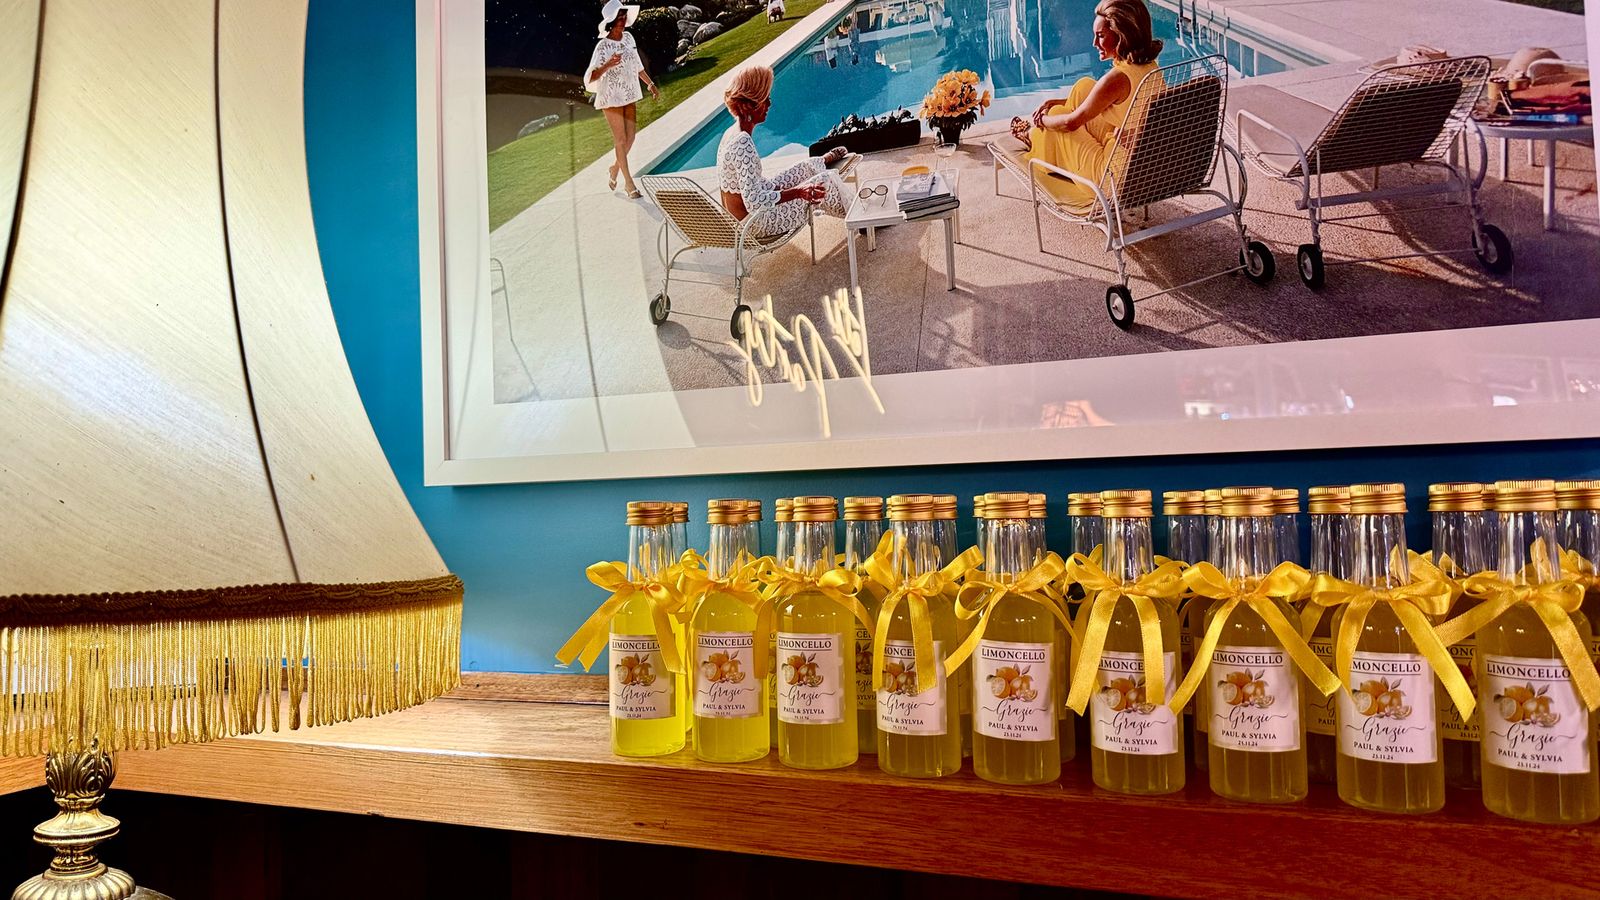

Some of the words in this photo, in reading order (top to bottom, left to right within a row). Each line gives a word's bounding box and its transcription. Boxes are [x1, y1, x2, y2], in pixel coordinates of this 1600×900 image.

[698, 637, 753, 646] LIMONCELLO
[778, 639, 832, 649] LIMONCELLO
[981, 648, 1046, 660] LIMONCELLO
[1212, 652, 1283, 664] LIMONCELLO
[1352, 660, 1421, 673] MONCELLO
[1487, 662, 1571, 679] LIMONCELLO
[784, 706, 796, 714] PAUL
[988, 722, 1006, 730] PAUL
[1442, 722, 1461, 730] PAUL
[1105, 735, 1122, 744] PAUL
[1221, 729, 1240, 738] PAUL
[1249, 732, 1277, 740] SYLVIA
[1353, 741, 1374, 751] PAUL
[1384, 745, 1414, 753] SYLVIA
[1498, 748, 1519, 759] PAUL
[1530, 753, 1563, 762] SYLVIA
